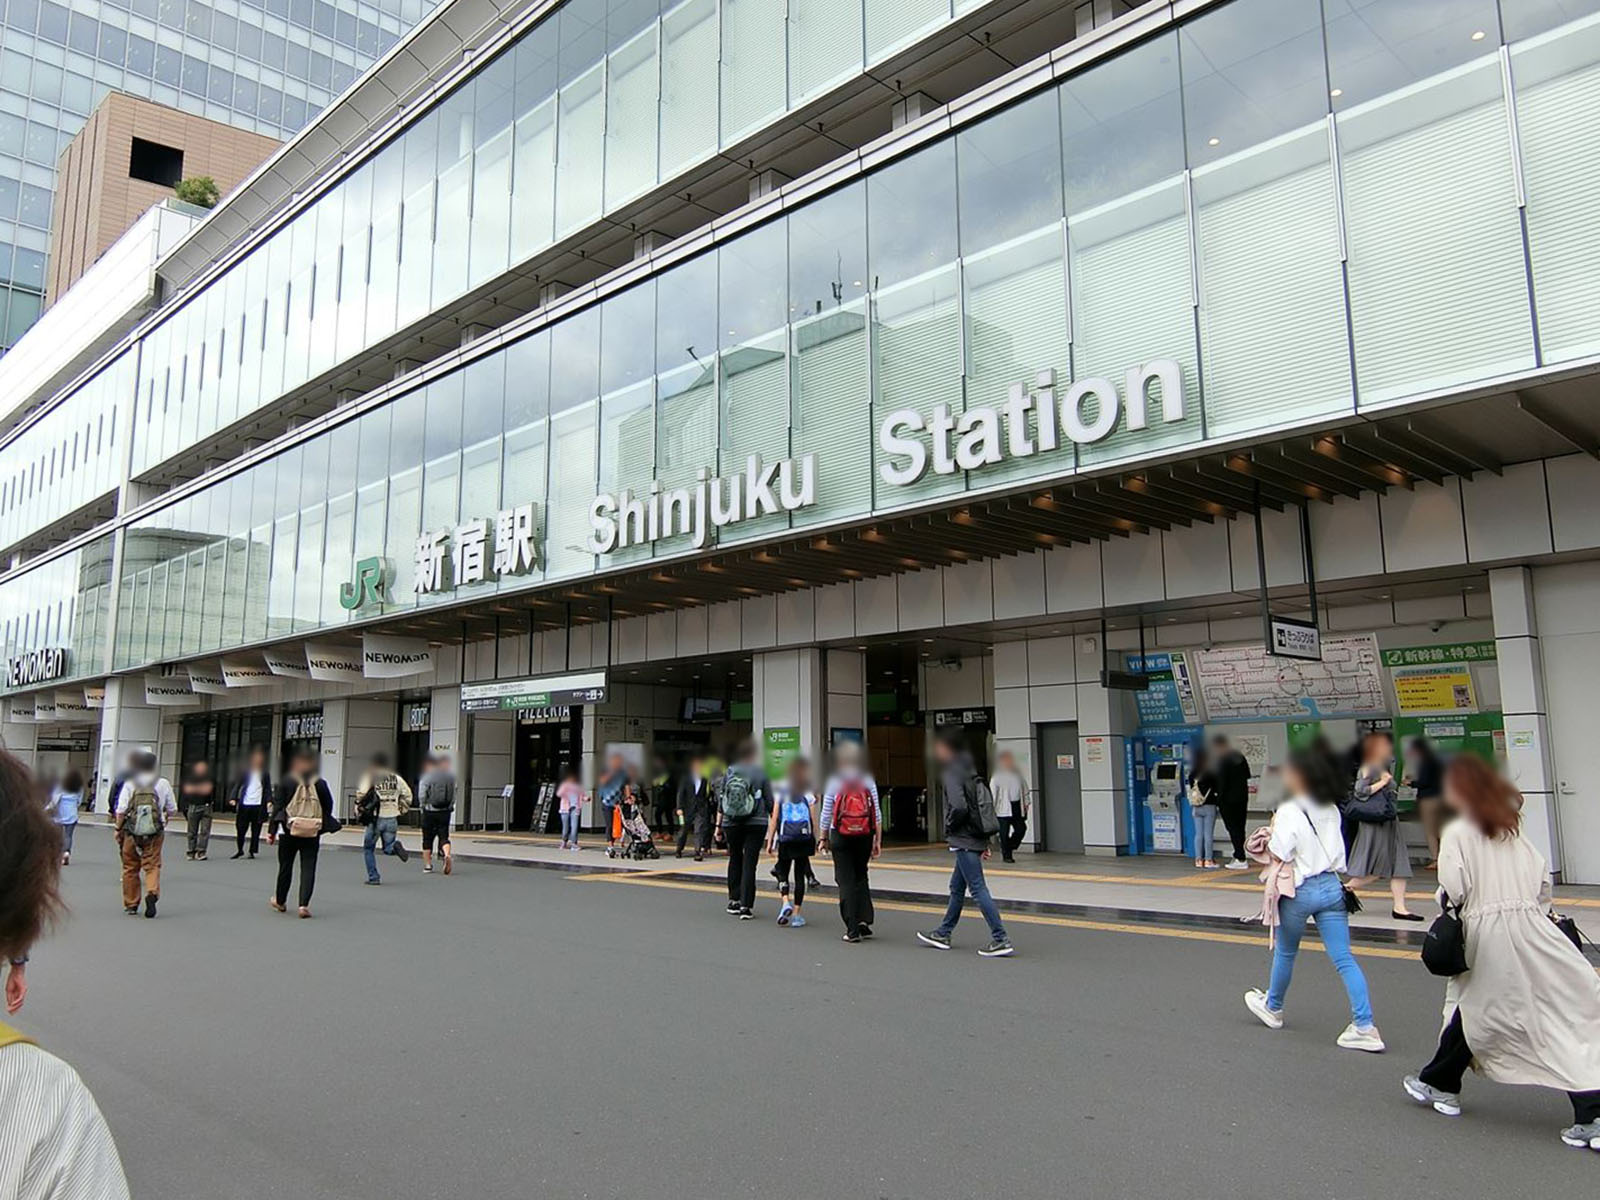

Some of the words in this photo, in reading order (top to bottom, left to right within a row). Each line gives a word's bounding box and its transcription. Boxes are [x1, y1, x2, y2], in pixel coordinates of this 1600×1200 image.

[340, 556, 384, 609] JR
[414, 502, 540, 594] 新宿駅
[587, 453, 817, 554] Shinjuku
[879, 357, 1186, 486] Station
[366, 652, 430, 664] NEWoMan
